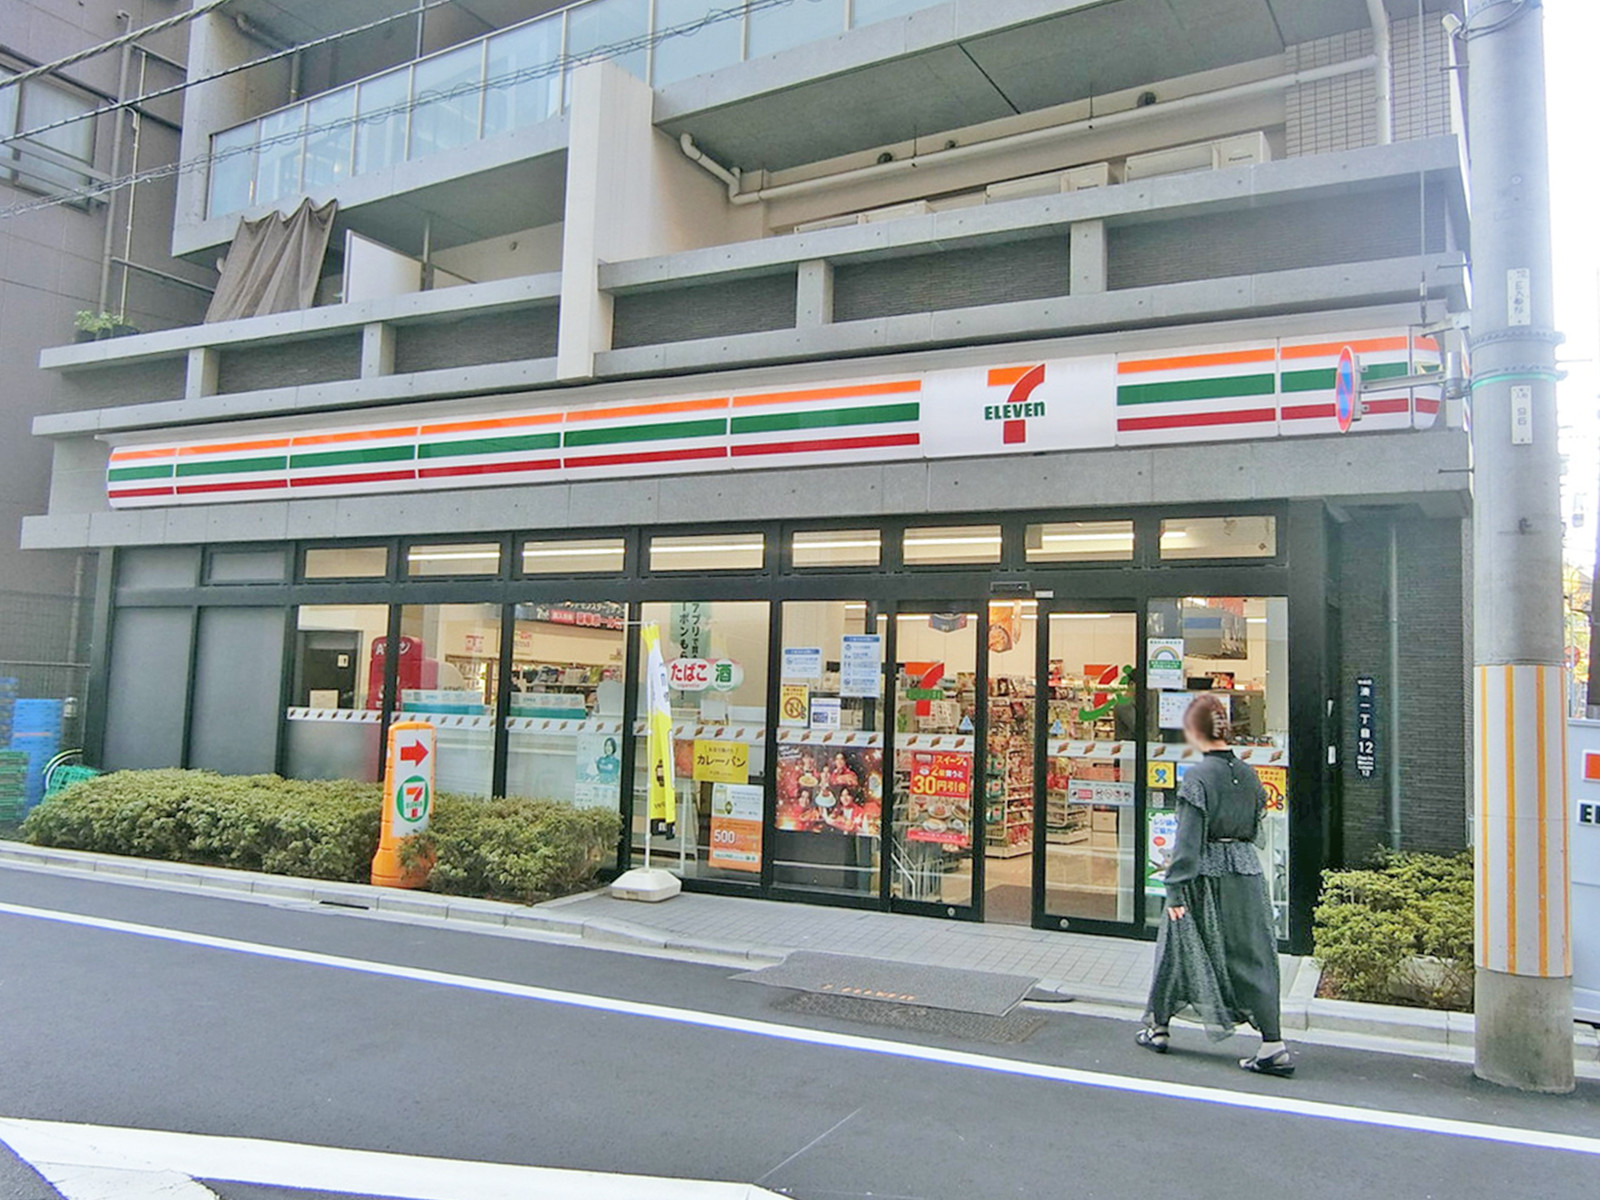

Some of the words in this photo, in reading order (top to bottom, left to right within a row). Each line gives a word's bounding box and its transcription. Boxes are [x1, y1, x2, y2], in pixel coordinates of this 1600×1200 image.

[987, 363, 1045, 444] 7
[670, 662, 708, 682] たばこ
[715, 663, 732, 683] 酒
[1359, 741, 1374, 754] 12
[697, 755, 746, 768] カレーパン
[714, 829, 735, 846] 500
